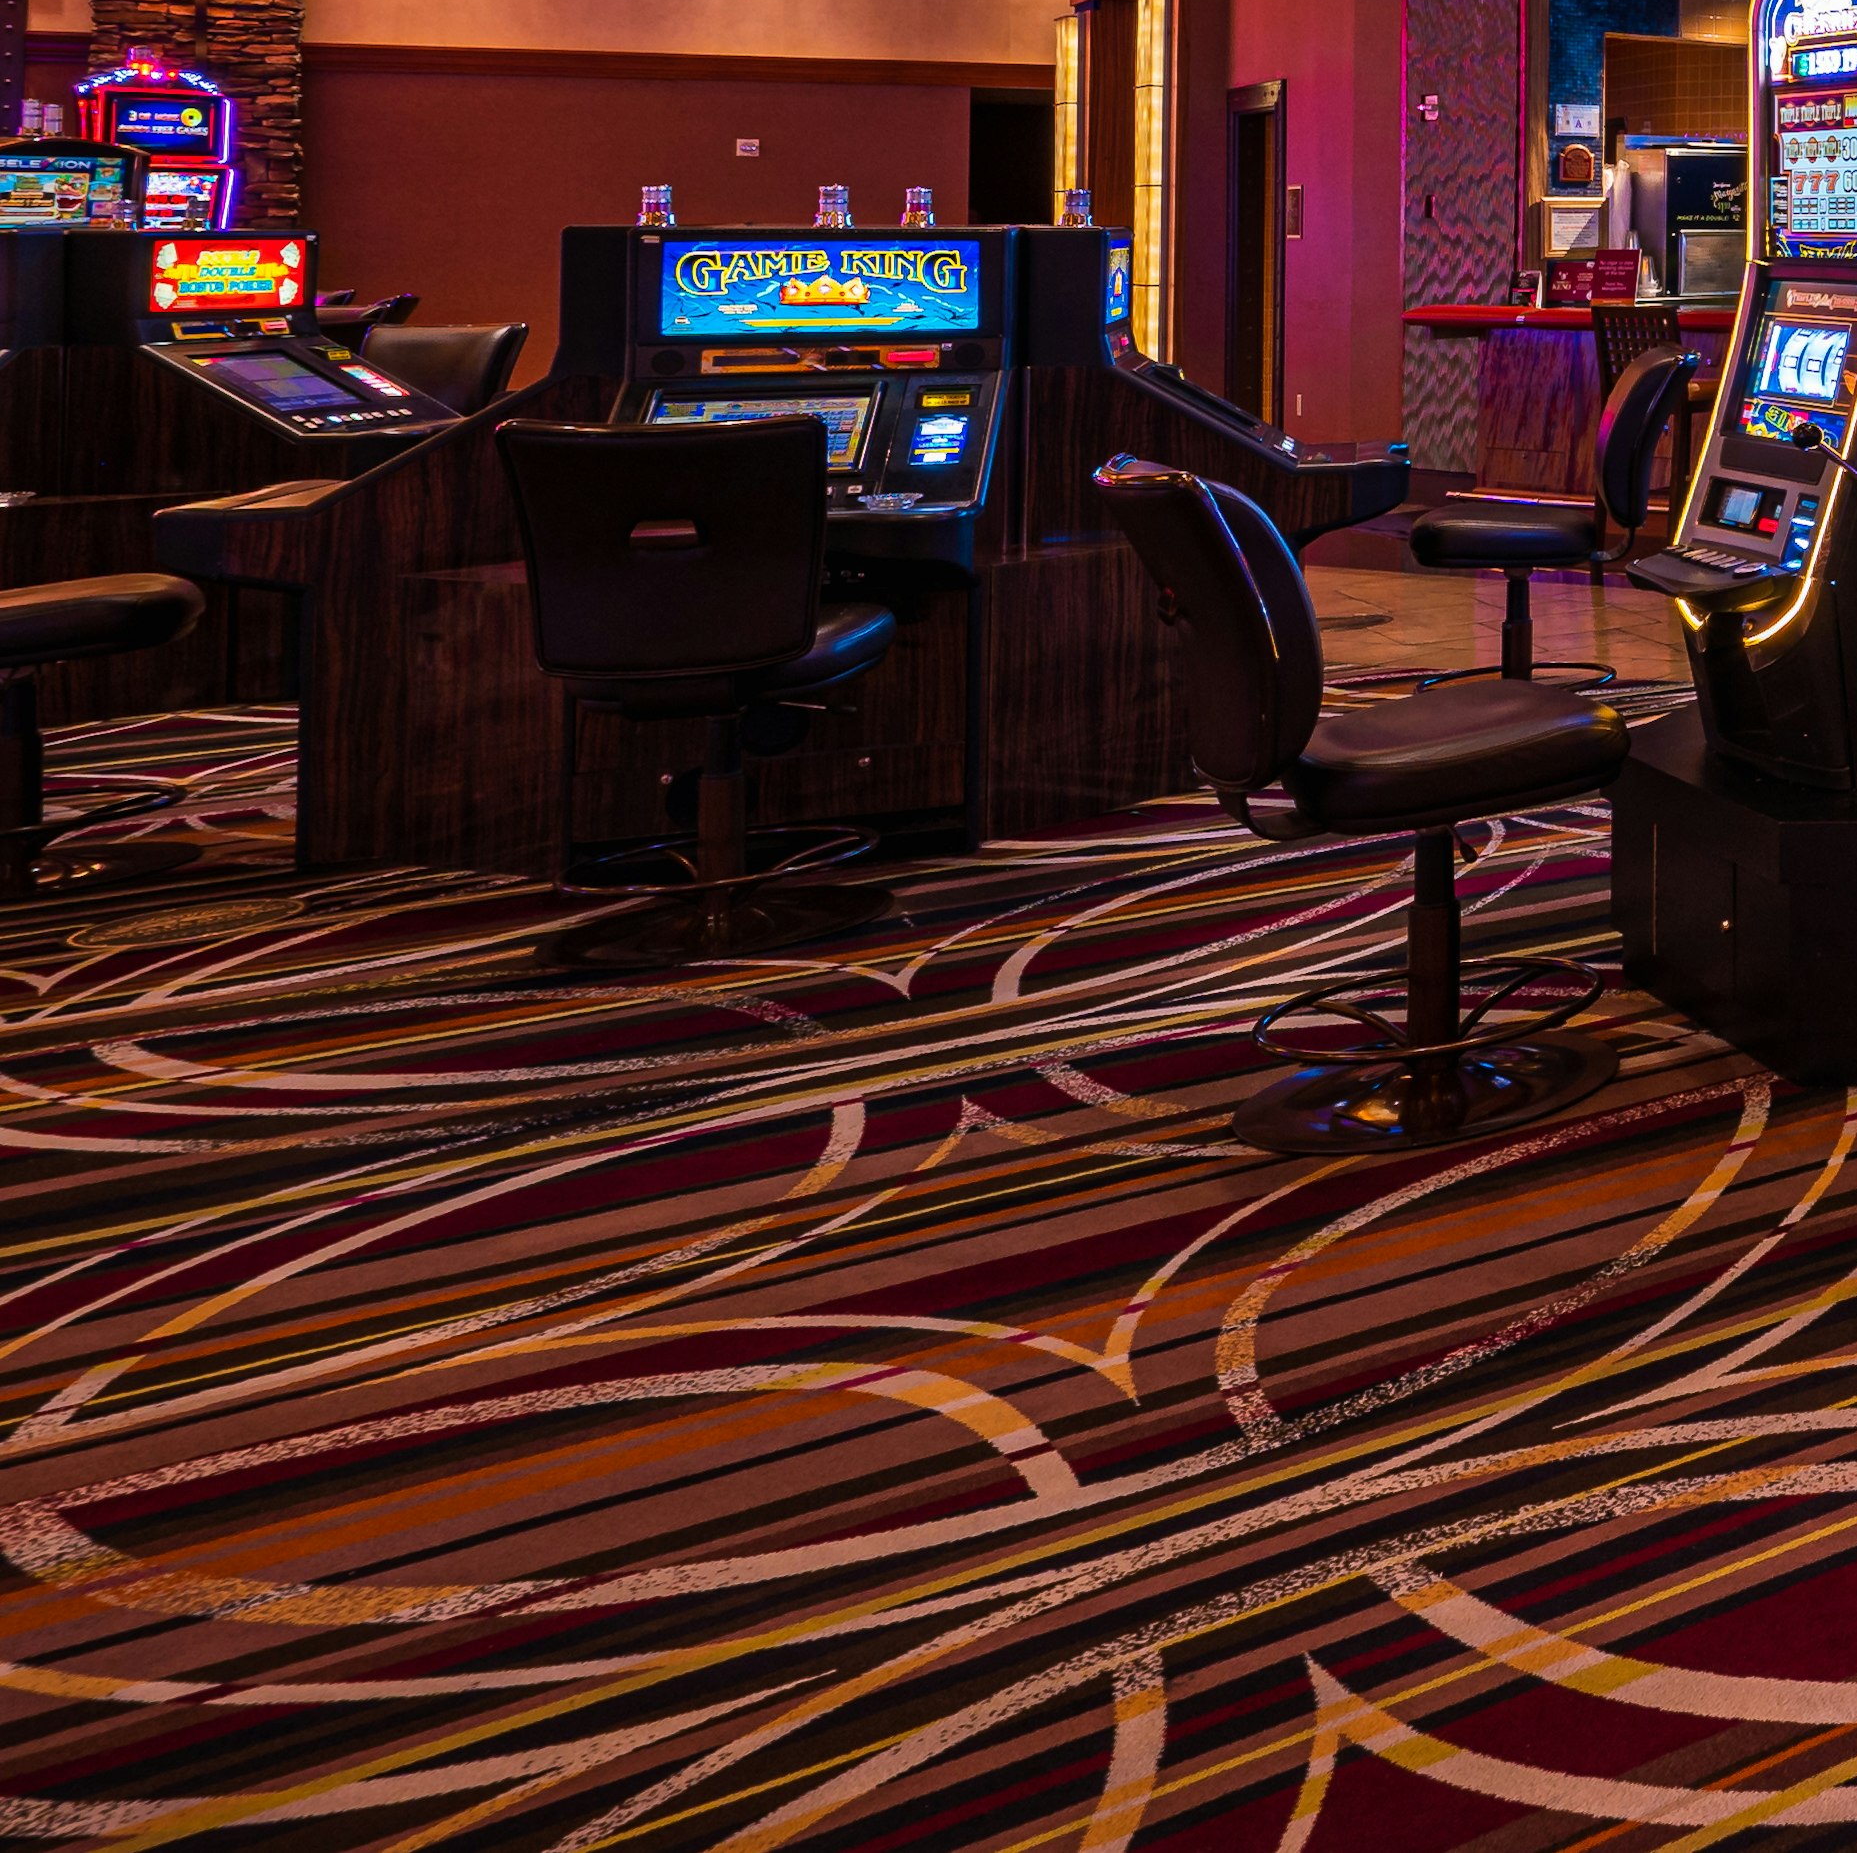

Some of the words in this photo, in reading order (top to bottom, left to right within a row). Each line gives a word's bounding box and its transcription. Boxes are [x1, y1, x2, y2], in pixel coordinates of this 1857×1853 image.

[1575, 119, 1583, 128] A
[176, 127, 208, 136] GAMES
[199, 265, 257, 278] DOUBLE
[676, 250, 831, 295] GAME
[841, 250, 968, 295] KING
[178, 280, 225, 294] BONUS
[228, 279, 275, 293] POKER
